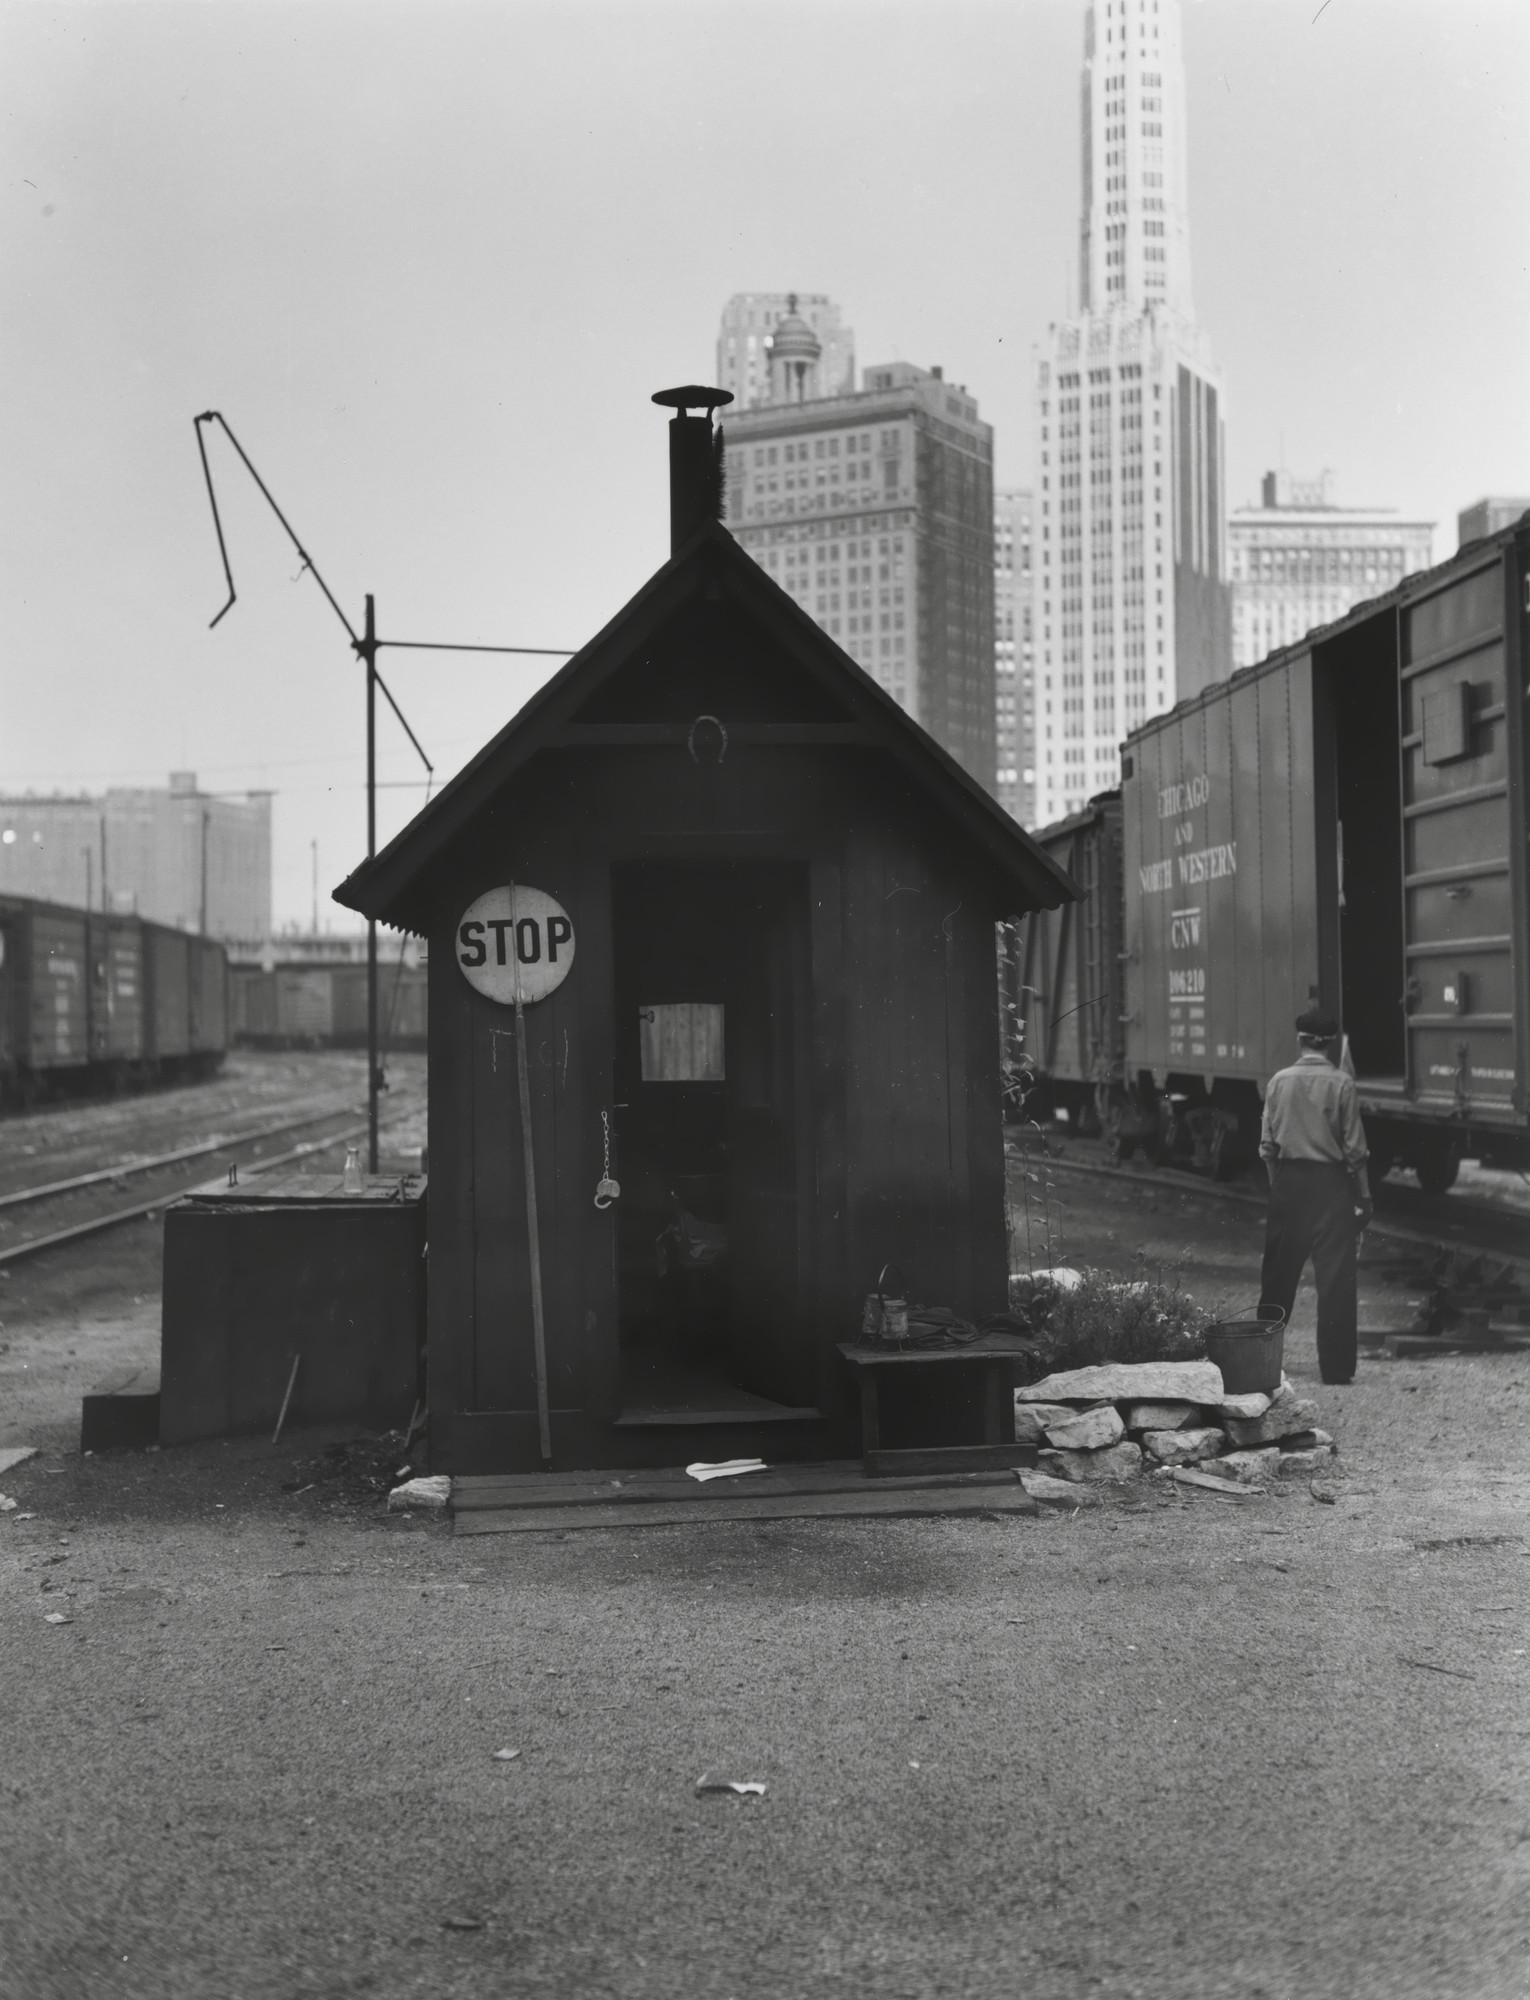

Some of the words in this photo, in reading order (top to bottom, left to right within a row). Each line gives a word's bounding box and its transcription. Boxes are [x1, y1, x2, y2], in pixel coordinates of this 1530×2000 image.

[1158, 774, 1209, 819] CHICAGO
[1174, 821, 1193, 846] AND
[1139, 858, 1173, 894] NORTH
[1178, 841, 1237, 884] WESTERN
[460, 916, 571, 967] STOP
